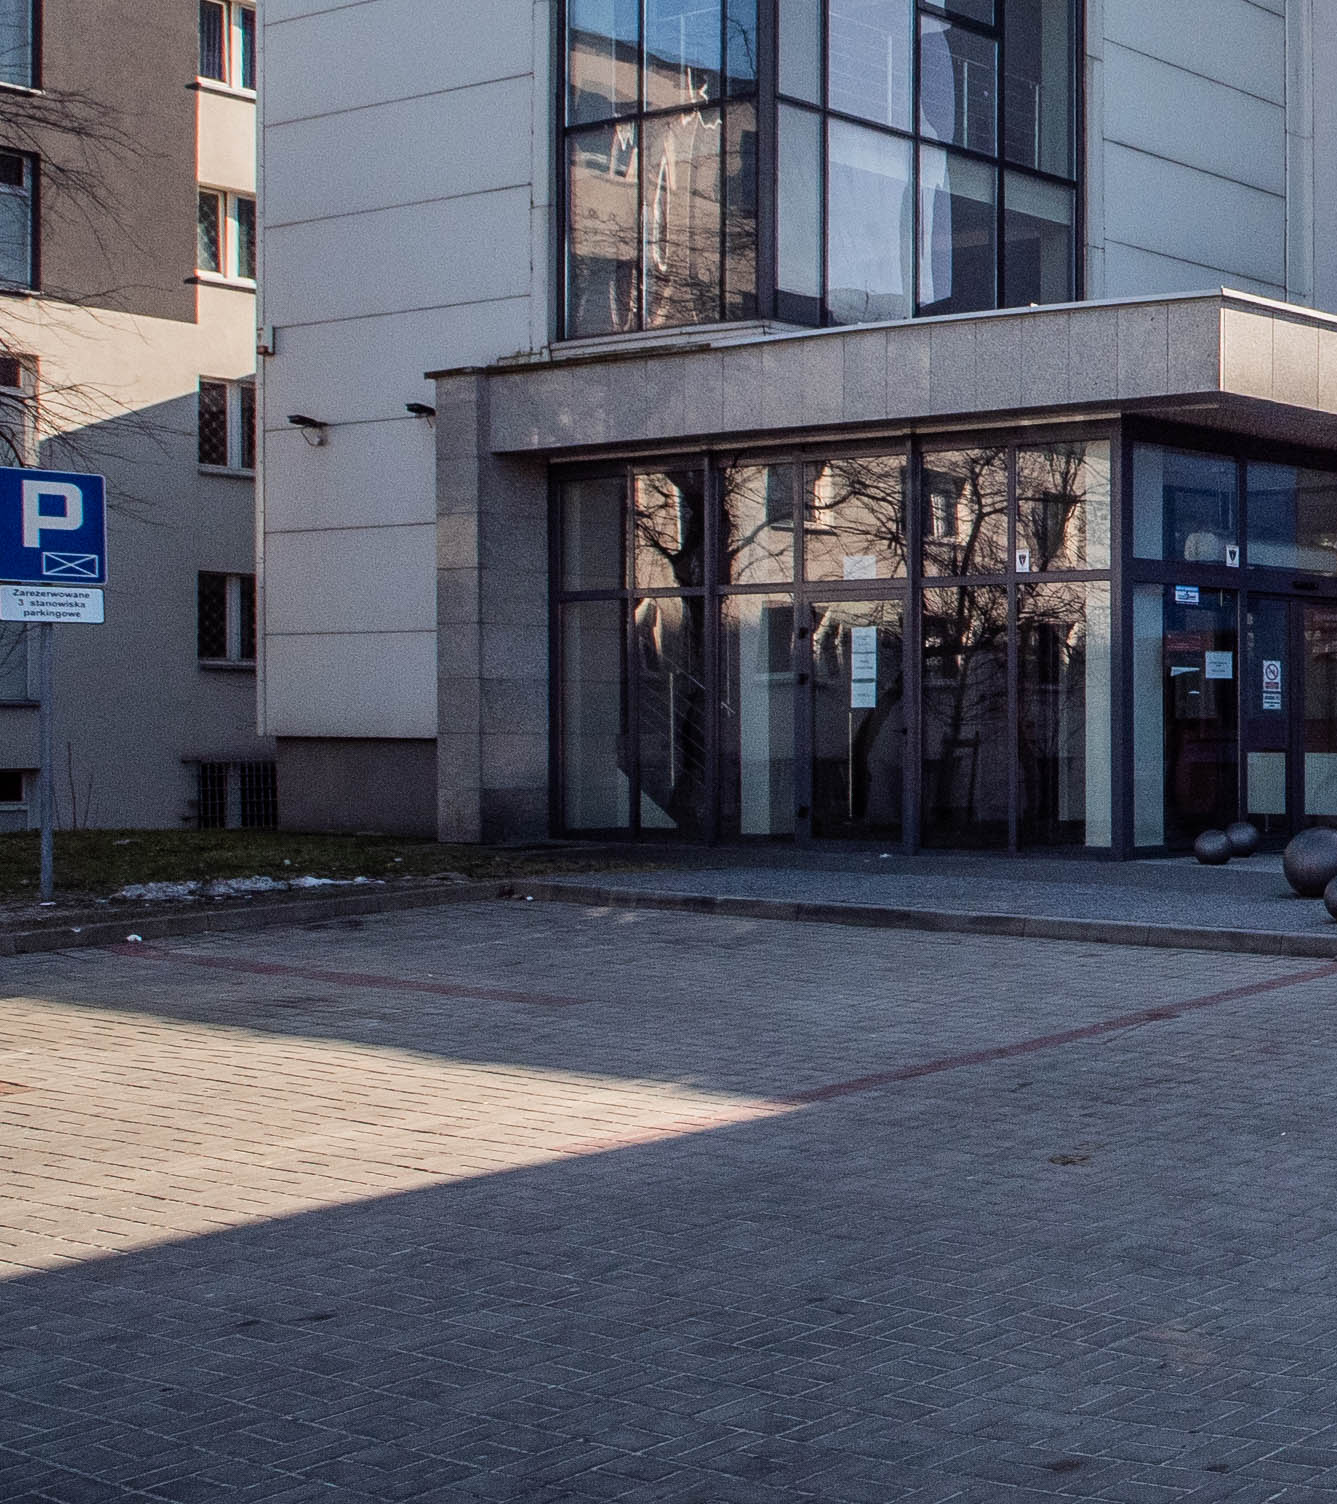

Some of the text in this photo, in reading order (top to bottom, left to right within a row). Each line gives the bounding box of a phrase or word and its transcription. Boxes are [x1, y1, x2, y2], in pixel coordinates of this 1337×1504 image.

[22, 479, 83, 548] P
[12, 588, 91, 599] Zarezerwowane
[30, 599, 86, 608] stanowiska
[23, 609, 81, 618] parkingowe
